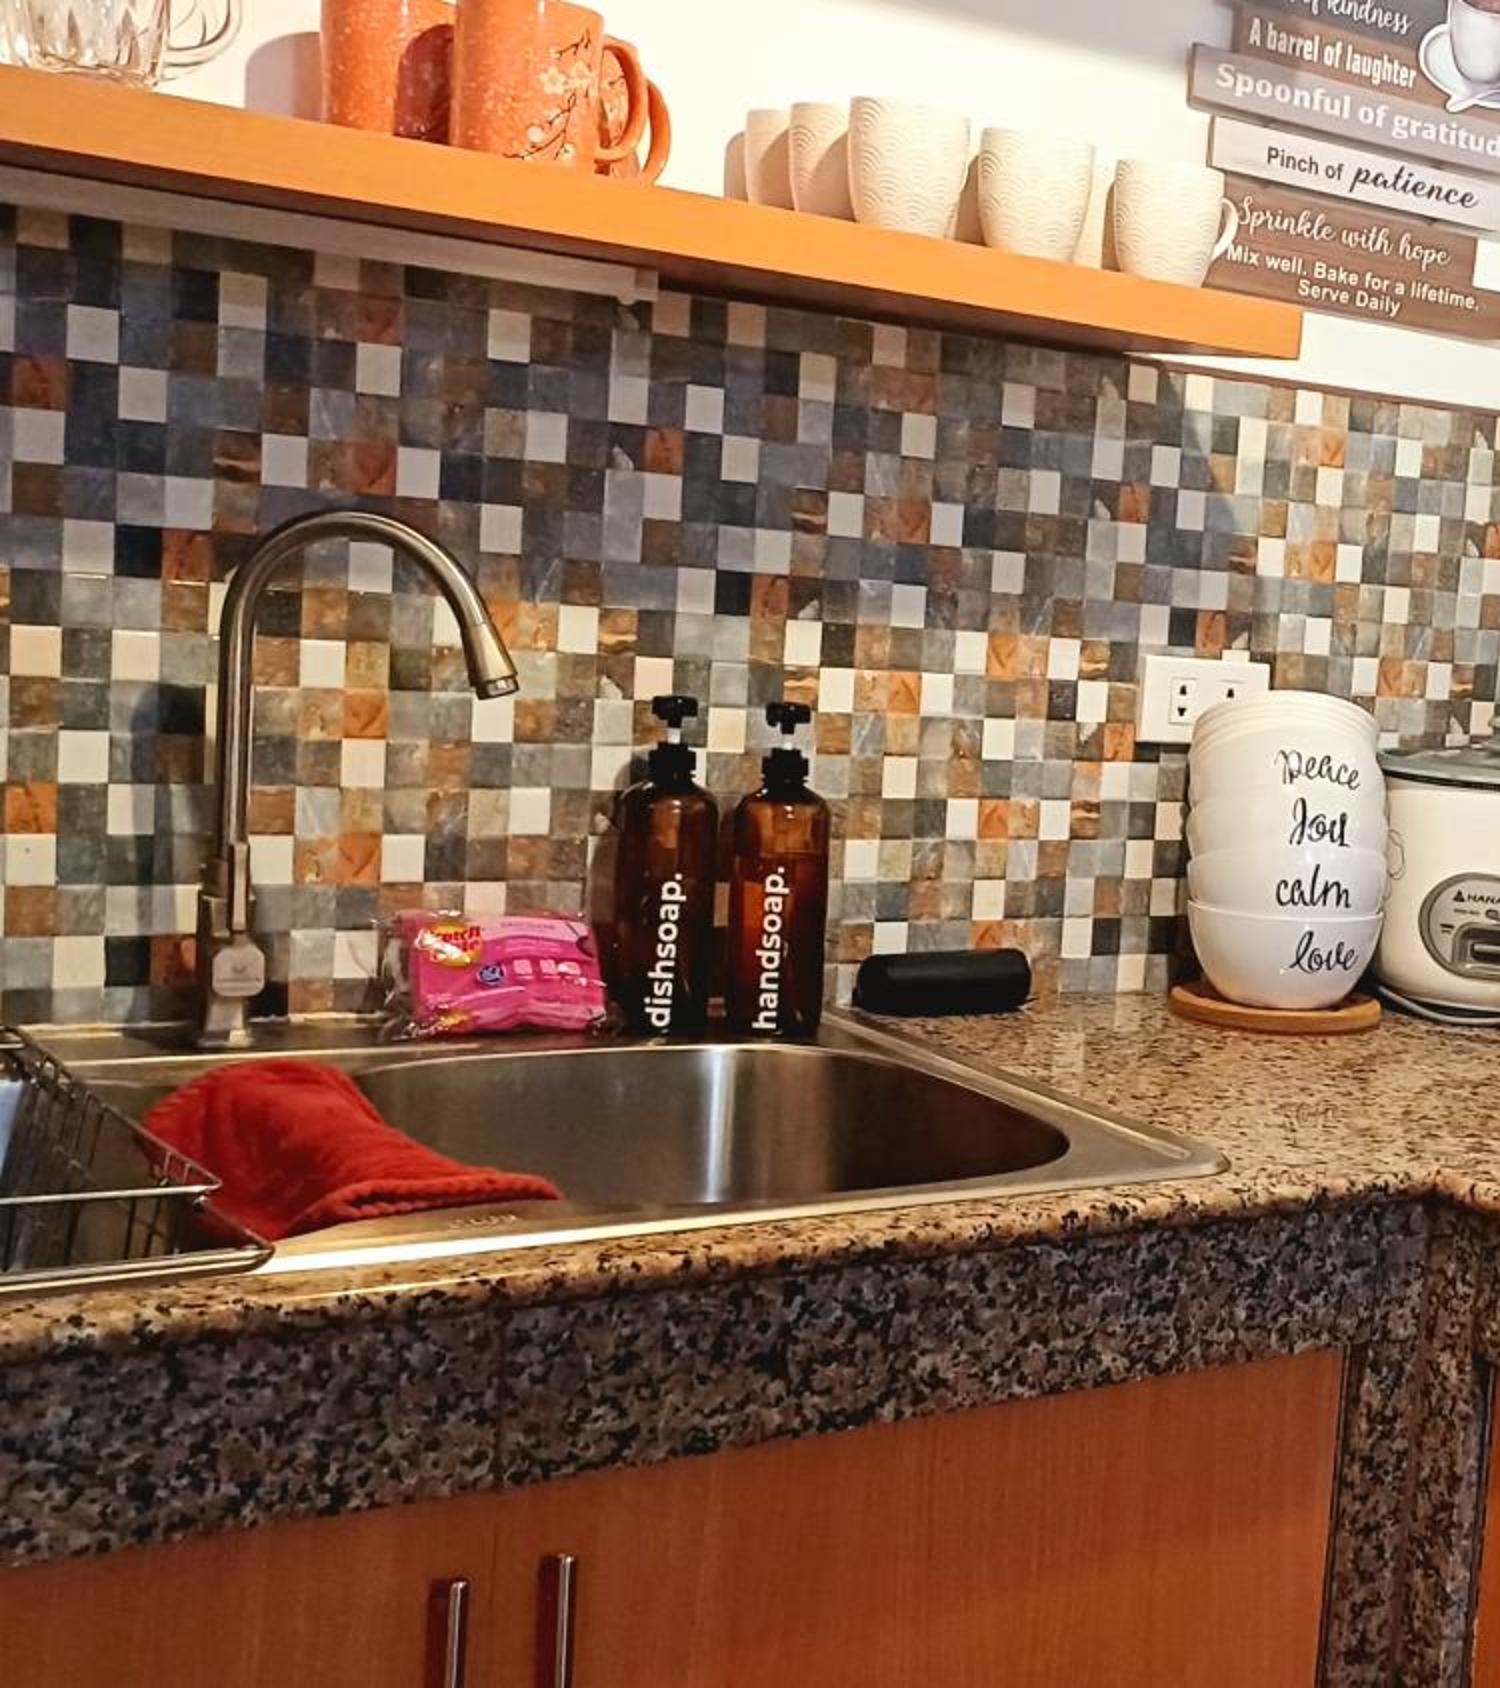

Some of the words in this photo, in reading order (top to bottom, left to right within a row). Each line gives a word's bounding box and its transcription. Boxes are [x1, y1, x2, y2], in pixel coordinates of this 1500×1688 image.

[1248, 17, 1261, 47] A
[1267, 22, 1320, 63] barrel
[1324, 41, 1343, 69] of
[1346, 44, 1417, 88] laughter
[1216, 63, 1350, 121] Spoonful
[1358, 104, 1386, 128] of
[1266, 146, 1319, 175] Pinch
[1325, 163, 1344, 181] of
[1349, 165, 1480, 209] patience
[1238, 196, 1336, 242] Sprinkle
[1341, 228, 1393, 256] with
[1398, 235, 1450, 273] hope
[1226, 244, 1259, 266] Mix
[1265, 255, 1307, 276] well.
[1314, 262, 1359, 287] Bake
[1364, 272, 1391, 293] for
[1395, 283, 1405, 295] a
[1411, 281, 1480, 311] lifetime.
[1298, 280, 1350, 304] Serve
[1355, 293, 1401, 318] Daily
[1274, 749, 1360, 790] peace
[1276, 863, 1351, 908] calm
[643, 873, 687, 1028] dishsoap.
[751, 866, 790, 1030] handsoap.
[1289, 930, 1359, 974] love
